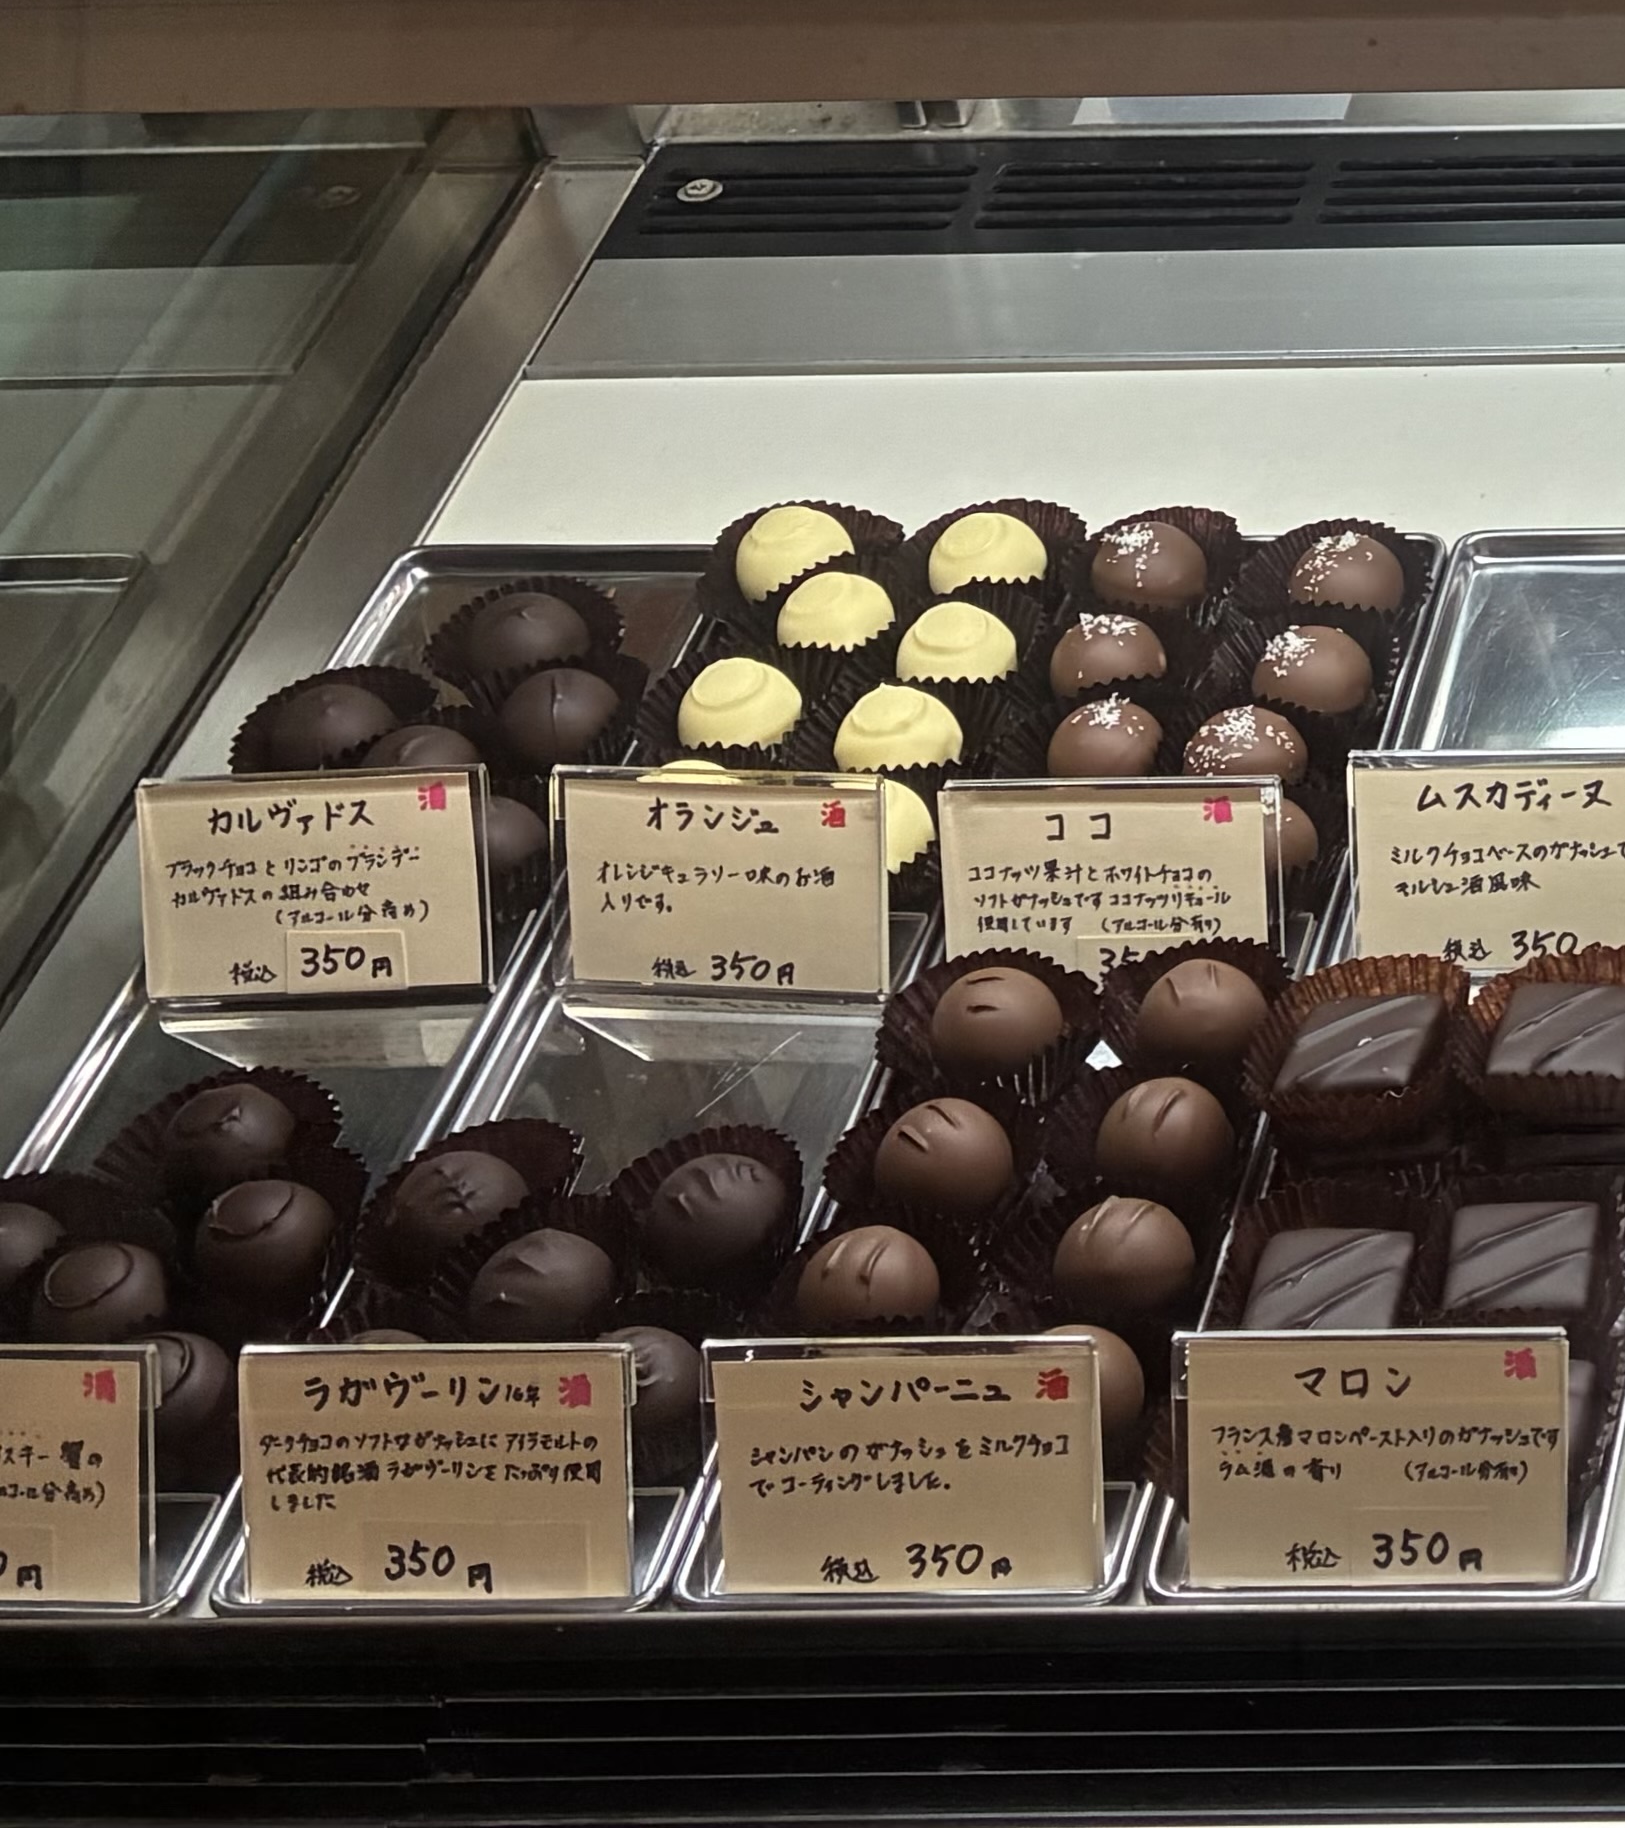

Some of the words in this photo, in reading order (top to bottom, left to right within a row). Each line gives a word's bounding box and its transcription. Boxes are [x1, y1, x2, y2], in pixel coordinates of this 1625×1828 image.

[1417, 778, 1612, 812] ムスカディーヌ
[207, 798, 374, 836] カルヴァドス
[646, 796, 780, 835] オランジュ
[1045, 812, 1111, 841] ココ
[228, 960, 278, 986] 税込
[300, 943, 393, 979] 350円
[651, 956, 697, 980] 税込
[711, 950, 795, 986] 350円
[799, 1376, 1012, 1413] シャンパーニュ
[1294, 1367, 1411, 1399] マロン
[305, 1558, 353, 1588] 税込
[384, 1539, 493, 1594] 350円
[820, 1555, 880, 1585] 税込
[905, 1542, 1013, 1580] 350円
[1285, 1539, 1342, 1573] 税込
[1371, 1527, 1483, 1572] 350円
